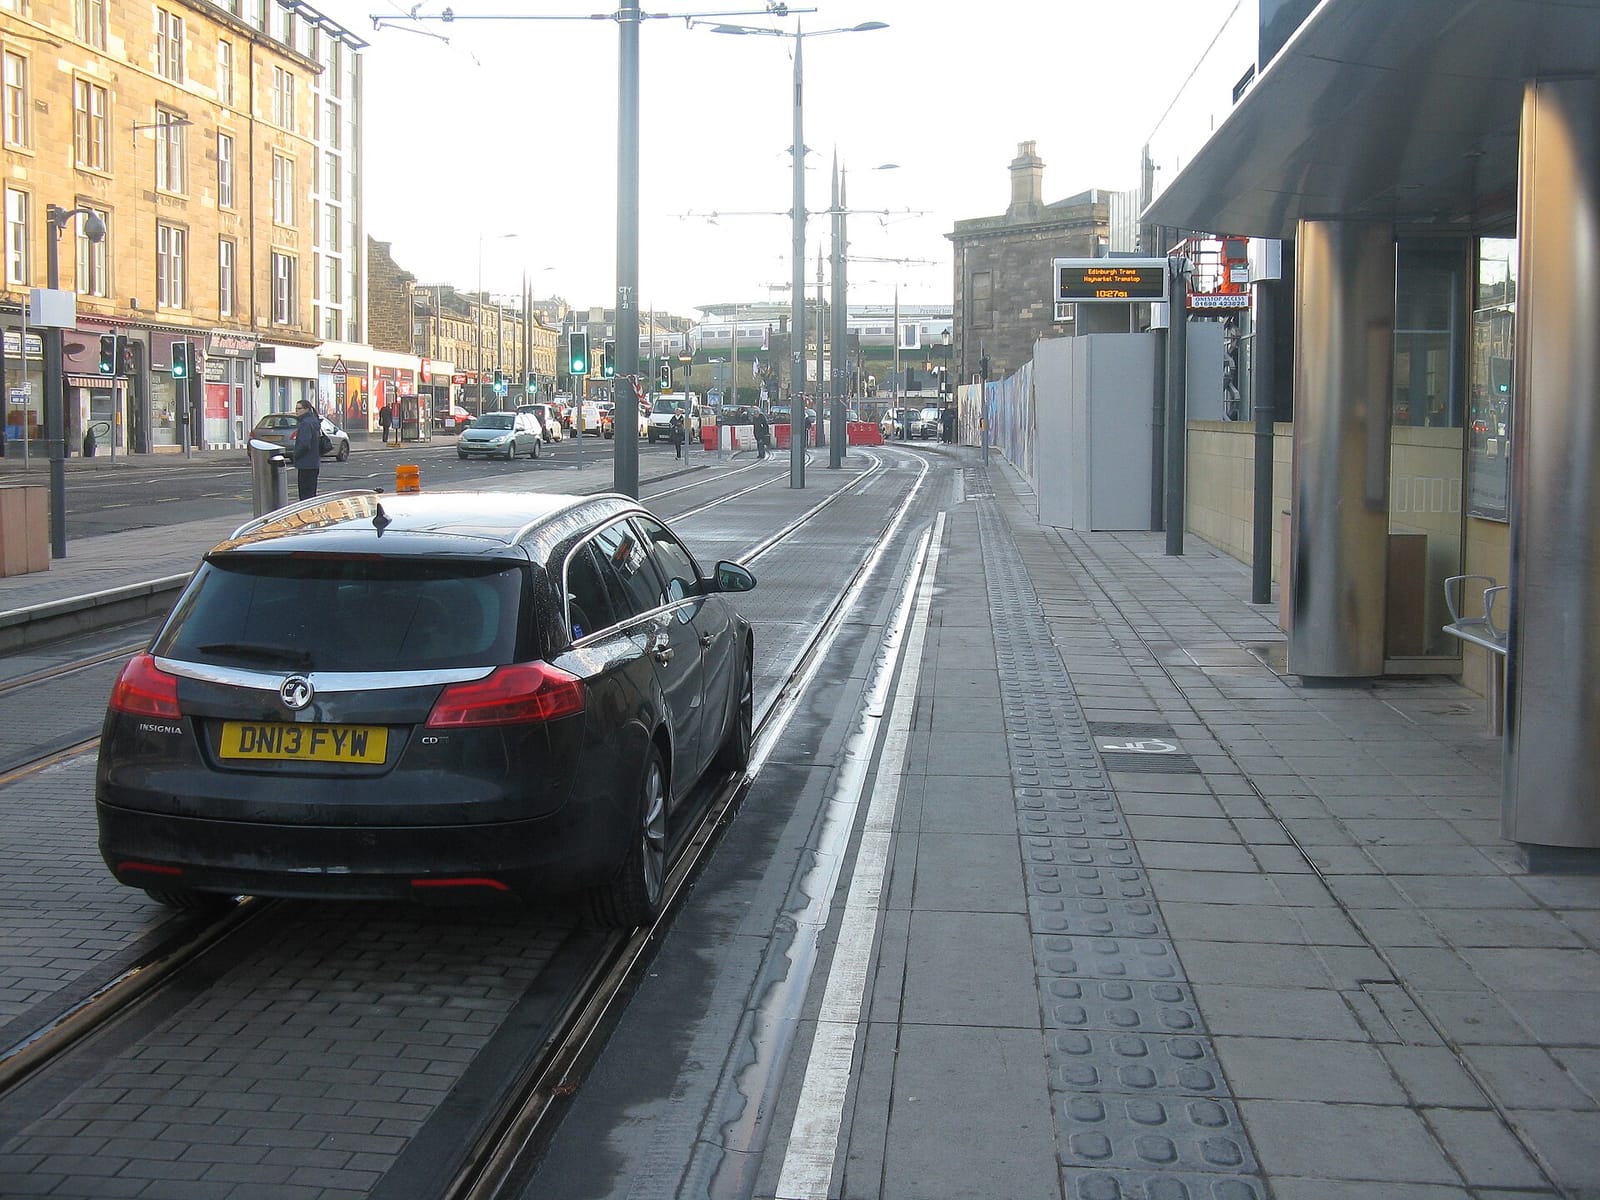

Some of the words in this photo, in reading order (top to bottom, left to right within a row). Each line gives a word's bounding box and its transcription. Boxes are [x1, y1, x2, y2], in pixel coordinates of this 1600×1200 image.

[1087, 268, 1118, 276] Edinburgh
[1083, 275, 1113, 283] Haymarket
[139, 723, 183, 736] INSIGNIA
[238, 725, 303, 755] DN13
[309, 726, 369, 758] FYW
